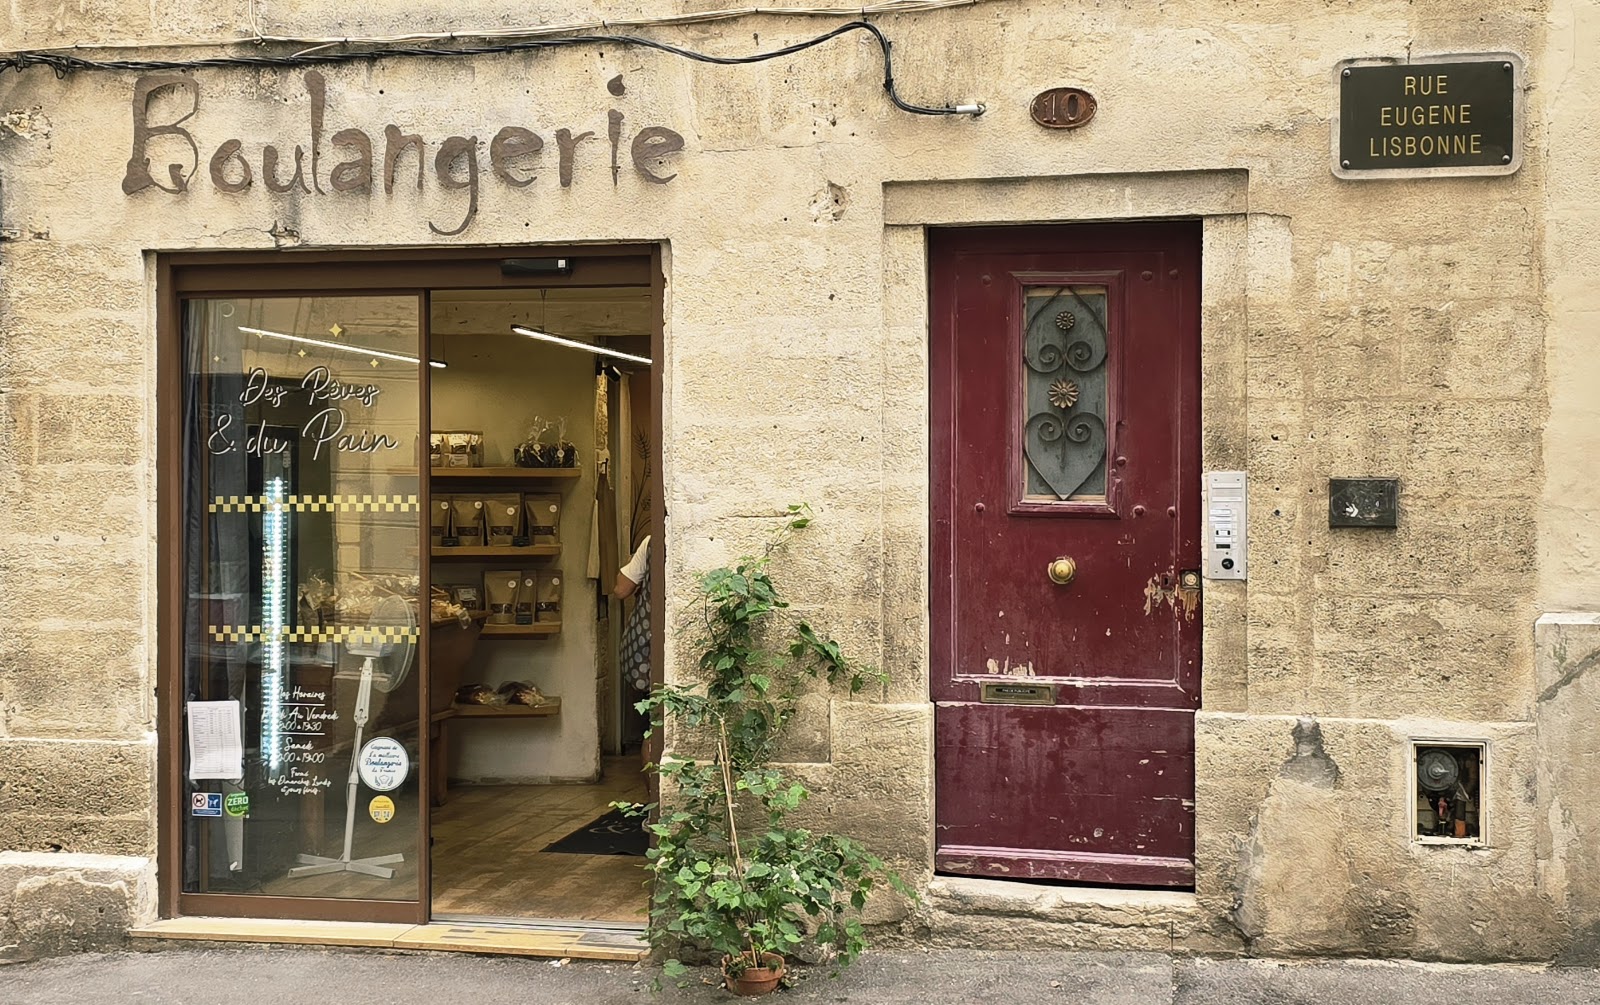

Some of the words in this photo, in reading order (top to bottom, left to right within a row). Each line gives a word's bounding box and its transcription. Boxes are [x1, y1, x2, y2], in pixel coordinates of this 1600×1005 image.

[1404, 75, 1448, 96] RUE
[1042, 92, 1087, 122] 10
[1381, 104, 1472, 126] EUGENE
[122, 70, 685, 235] Boulangerie
[1370, 134, 1482, 157] LISBONNE
[239, 366, 288, 408] Des
[301, 366, 380, 408] Rêves
[207, 413, 237, 456] &
[246, 419, 288, 458] du
[302, 407, 399, 461] Pain
